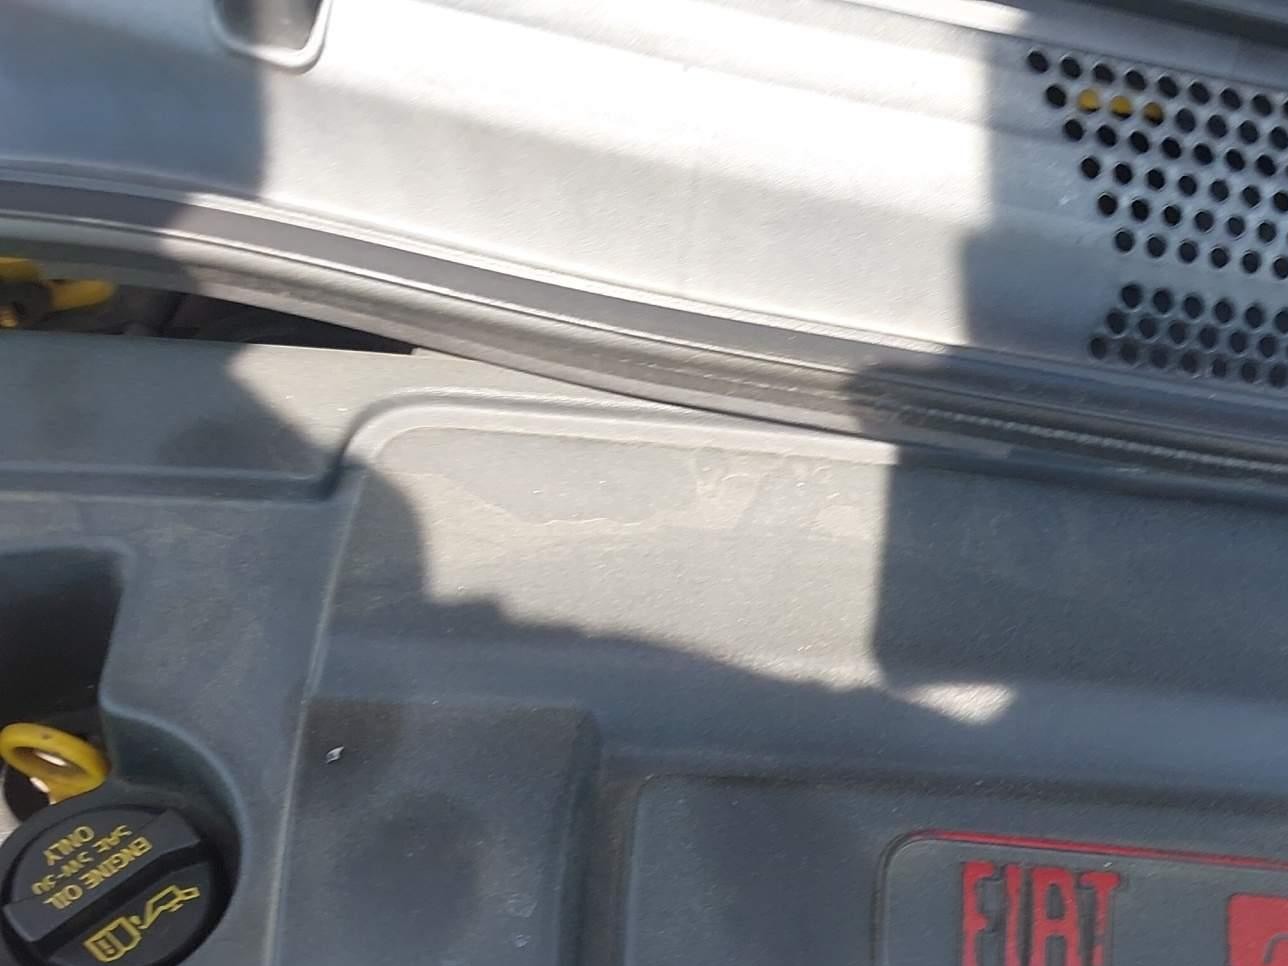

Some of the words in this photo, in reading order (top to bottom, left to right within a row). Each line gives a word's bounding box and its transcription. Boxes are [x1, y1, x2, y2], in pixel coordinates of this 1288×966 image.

[42, 825, 95, 866] ONLY
[79, 836, 153, 889] ENGINE
[42, 884, 83, 910] OIL
